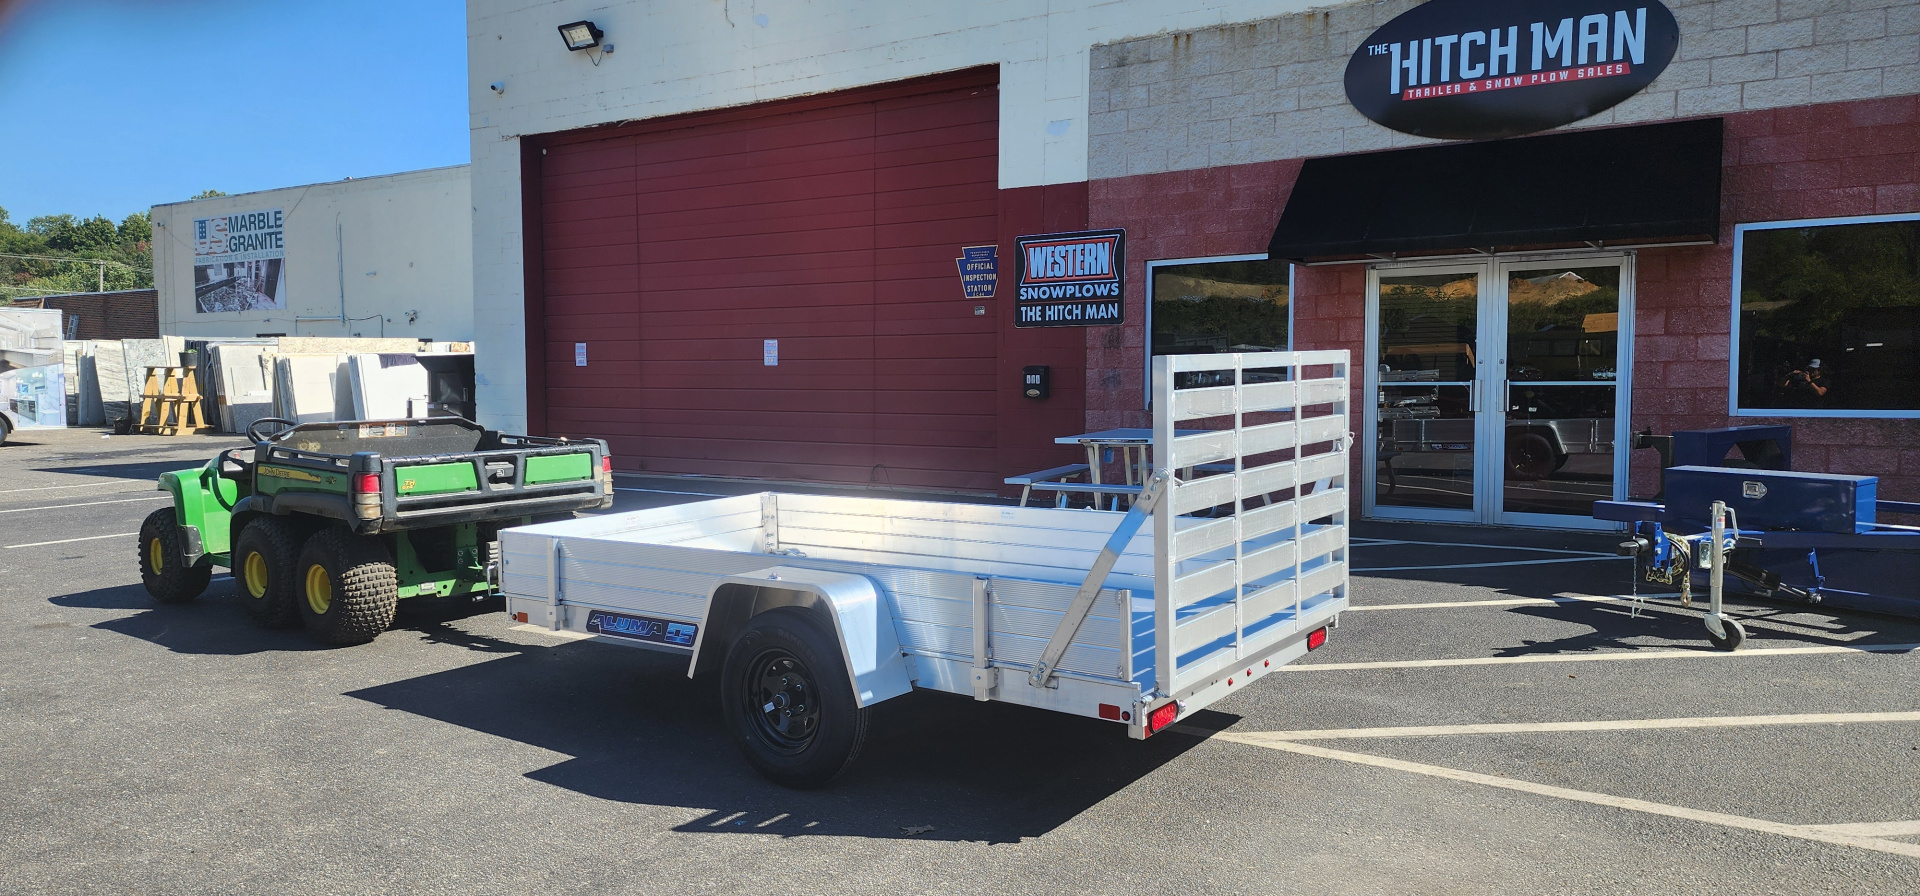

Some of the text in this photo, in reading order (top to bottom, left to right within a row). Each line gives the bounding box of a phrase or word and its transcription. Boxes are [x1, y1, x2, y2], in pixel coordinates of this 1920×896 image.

[1368, 7, 1647, 95] THE HITCH MAN
[1408, 64, 1623, 99] TRAILER & SNOW PLOW SALES
[228, 210, 283, 233] MARBLE
[194, 218, 228, 255] US
[228, 231, 283, 253] GRANITE
[195, 254, 233, 264] FABRICATION
[240, 250, 284, 260] INSTALLATION
[966, 262, 994, 271] OFFICIAL
[1028, 242, 1110, 279] WESTERN
[963, 273, 997, 282] INSPECTION
[966, 284, 992, 293] STATION
[1020, 283, 1119, 300] SNOWPLOWS
[1021, 303, 1118, 322] THE HITCH MAN
[263, 467, 275, 476] JOHN
[590, 614, 663, 637] ALUMA
